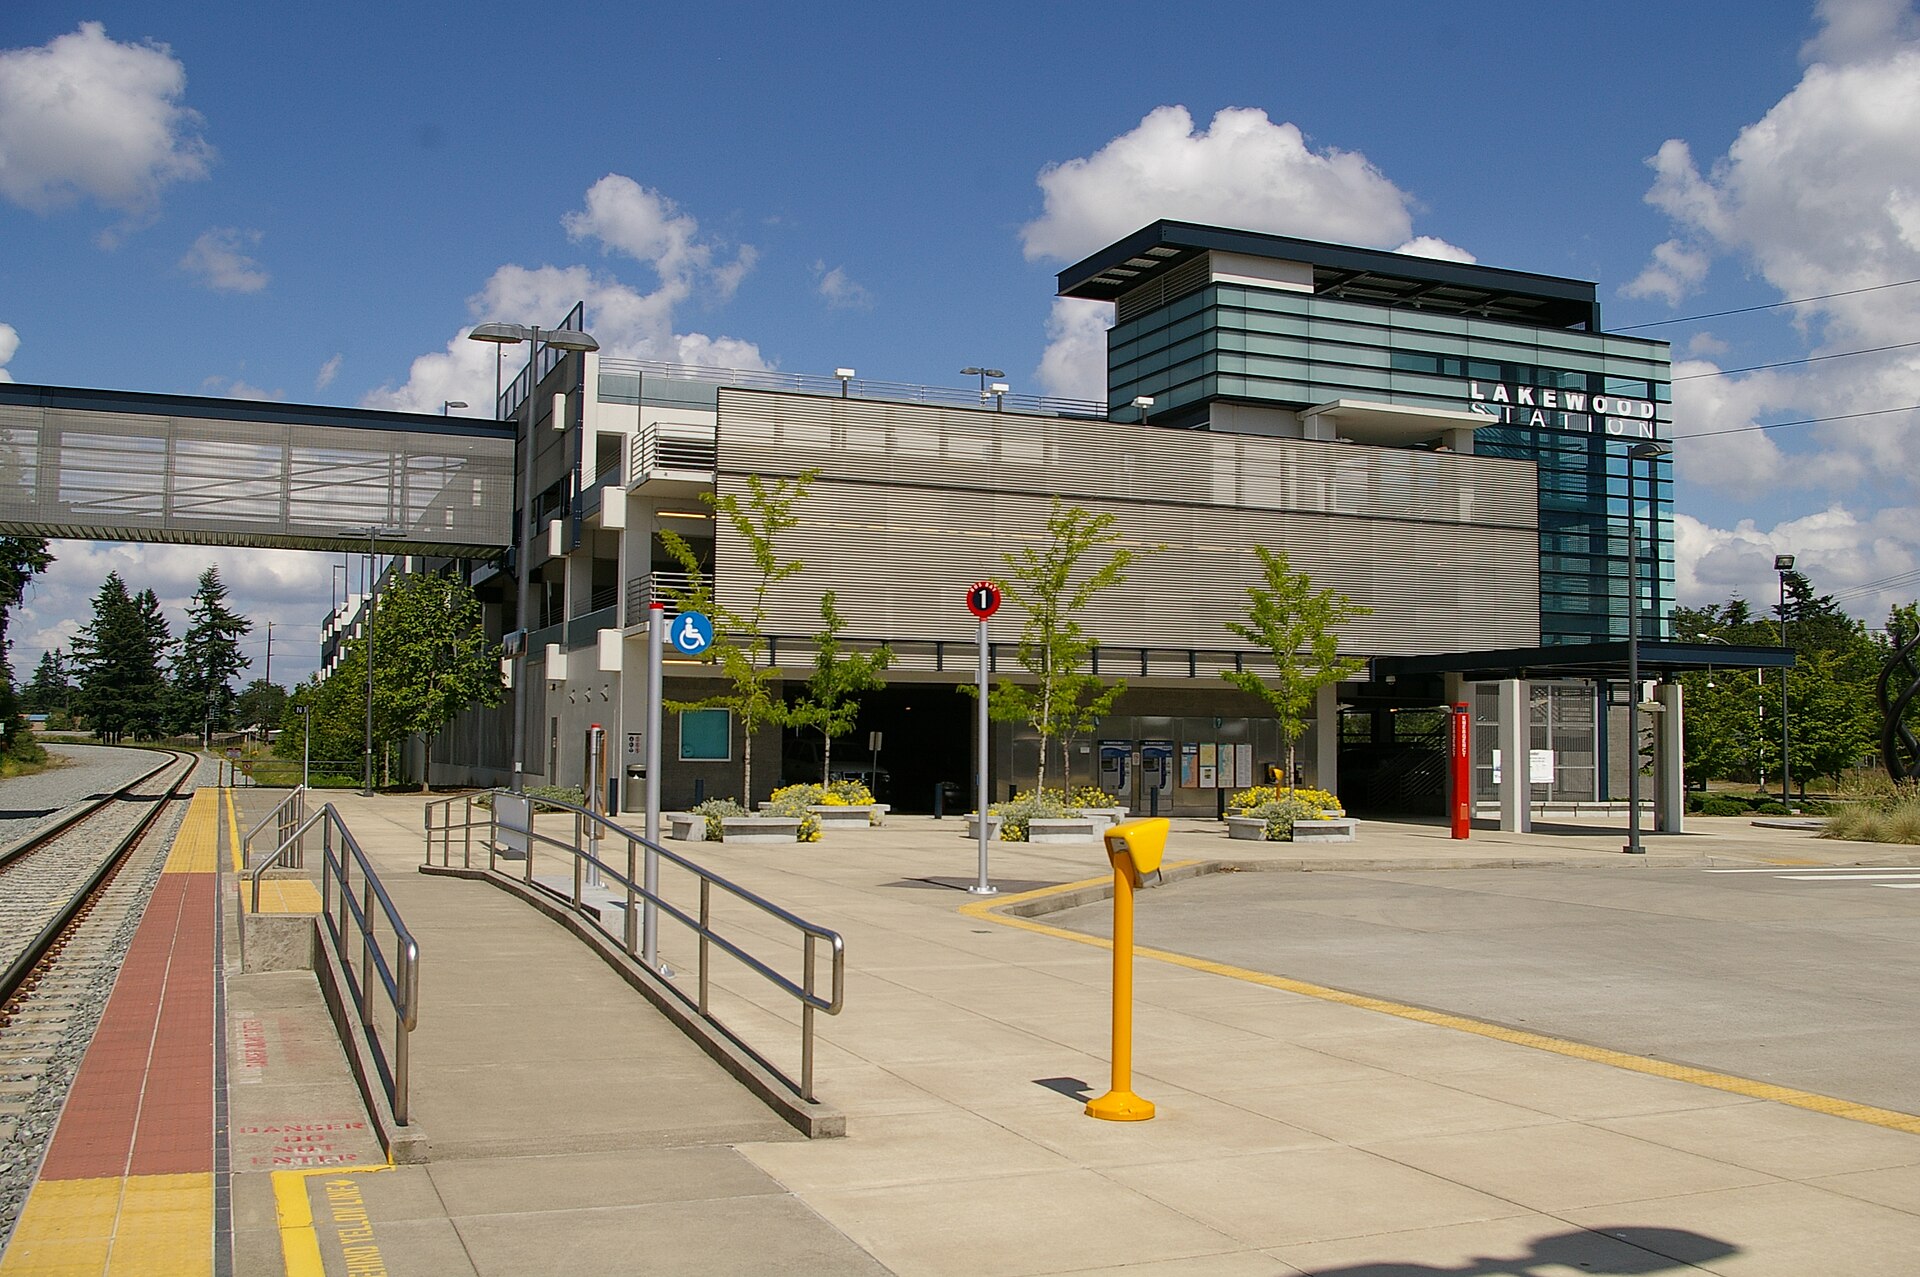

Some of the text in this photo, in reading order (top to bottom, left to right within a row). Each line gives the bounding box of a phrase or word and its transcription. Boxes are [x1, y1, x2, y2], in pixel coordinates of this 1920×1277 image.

[1471, 380, 1655, 419] LAKEWOOD
[1471, 401, 1654, 439] STATION
[979, 589, 986, 608] 1
[240, 1122, 364, 1134] DANGER
[273, 1143, 334, 1153] NOT
[325, 1185, 364, 1206] LINE
[331, 1207, 376, 1245] YELLOW
